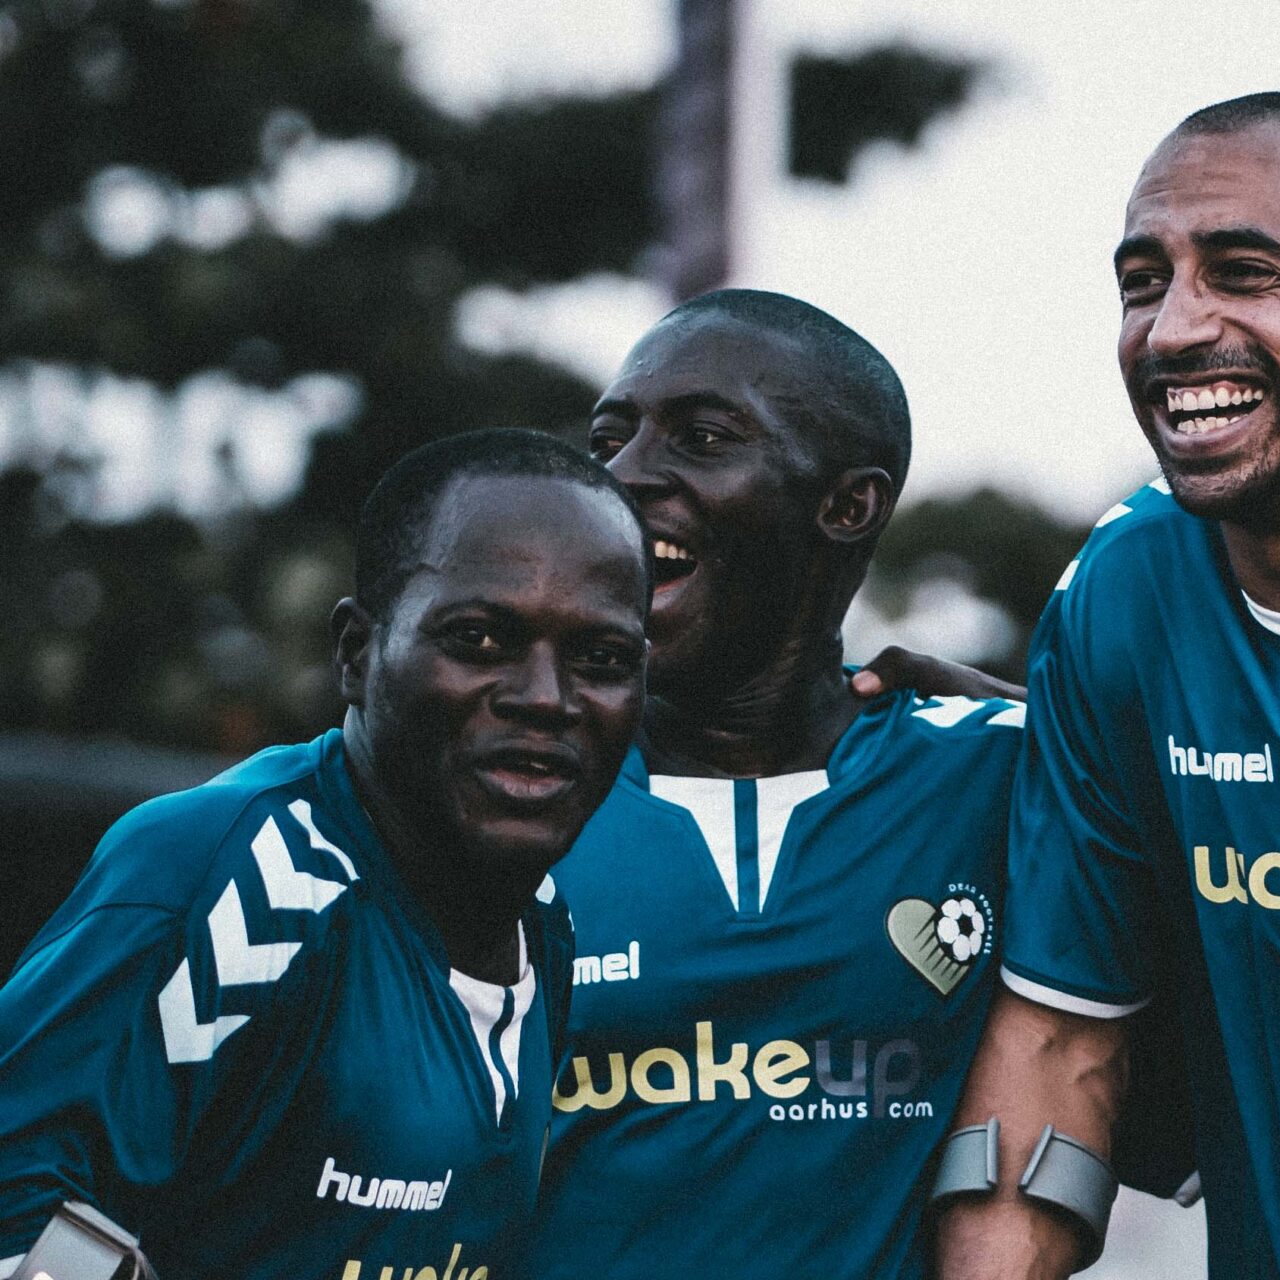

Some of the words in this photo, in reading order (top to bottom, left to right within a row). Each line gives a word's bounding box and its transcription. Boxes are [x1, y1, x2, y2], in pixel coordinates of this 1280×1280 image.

[1167, 734, 1275, 783] humel
[769, 1098, 869, 1121] aarhus
[316, 1157, 453, 1211] hummel
